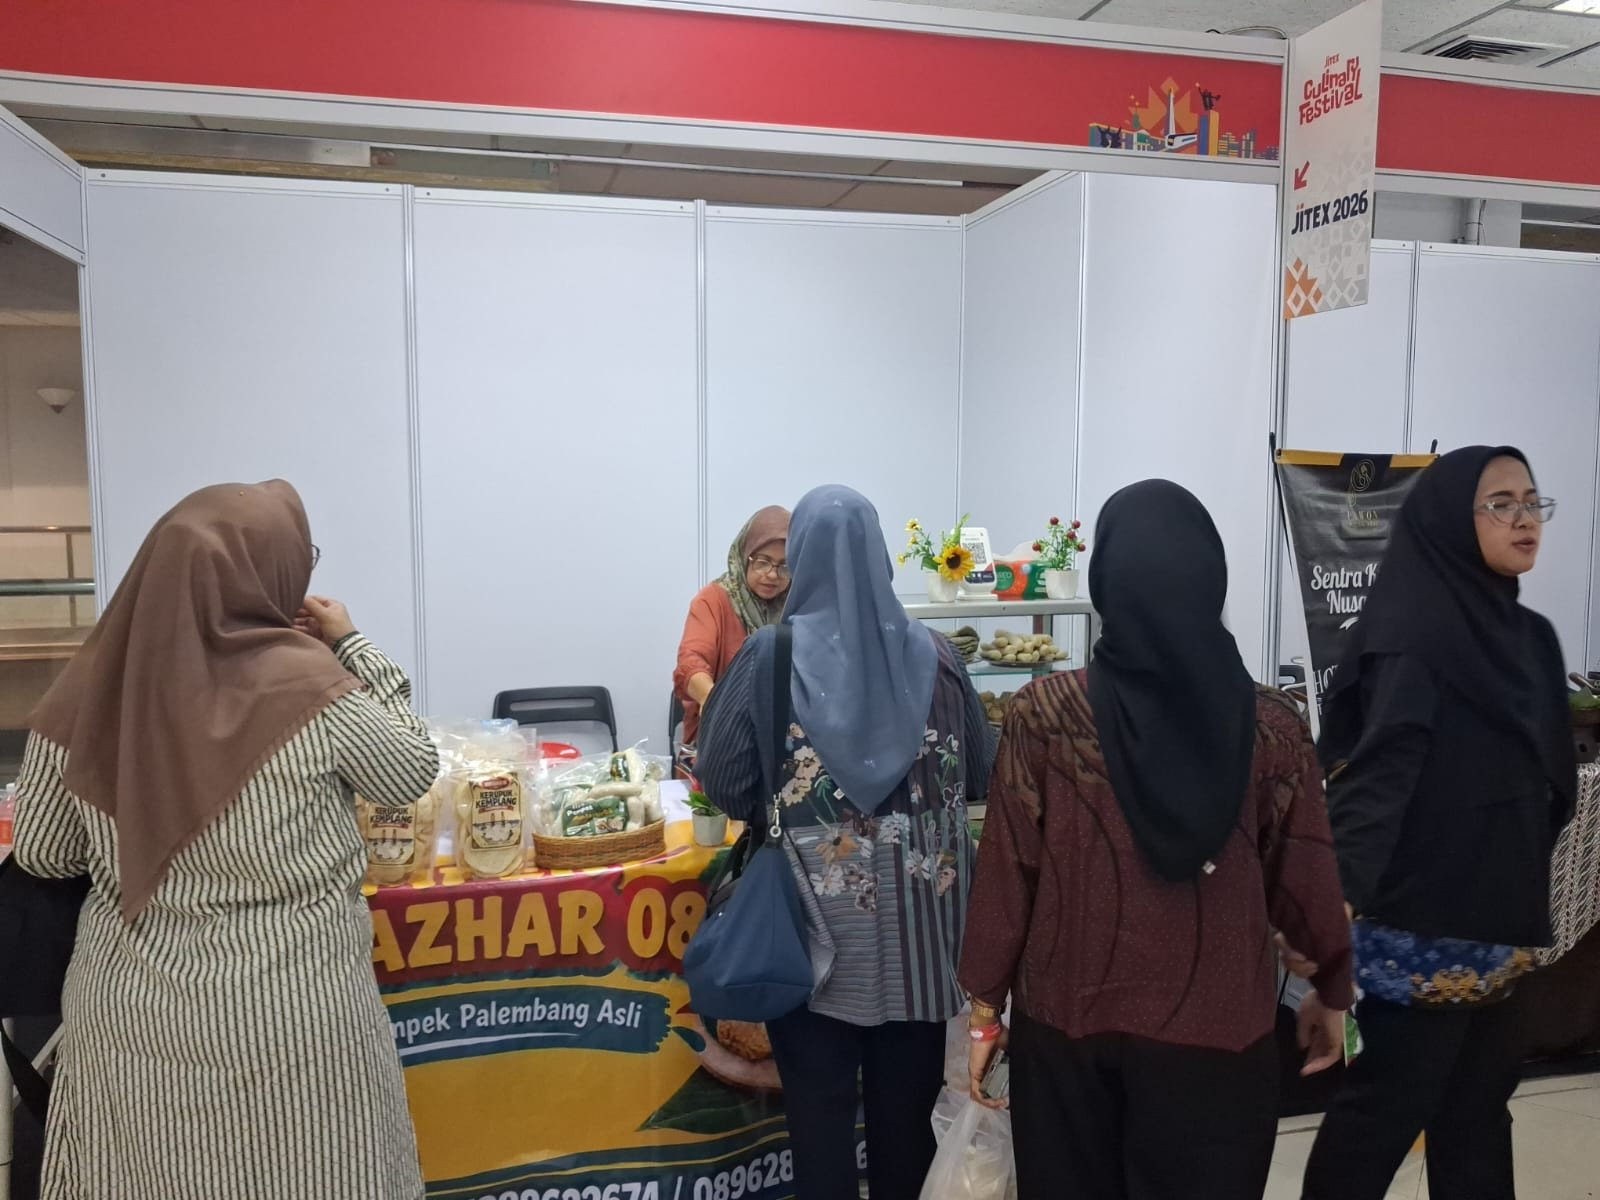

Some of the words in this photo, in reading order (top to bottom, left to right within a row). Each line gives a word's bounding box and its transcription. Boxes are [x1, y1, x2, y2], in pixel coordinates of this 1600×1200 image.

[1333, 190, 1368, 224] 2026
[1310, 564, 1363, 591] Sentra
[1365, 562, 1377, 587] K
[476, 797, 517, 808] KEMPLANG
[372, 889, 606, 972] AZHAR
[460, 997, 589, 1028] Palembang
[597, 999, 642, 1028] Asli
[693, 1149, 794, 1200] 089628
